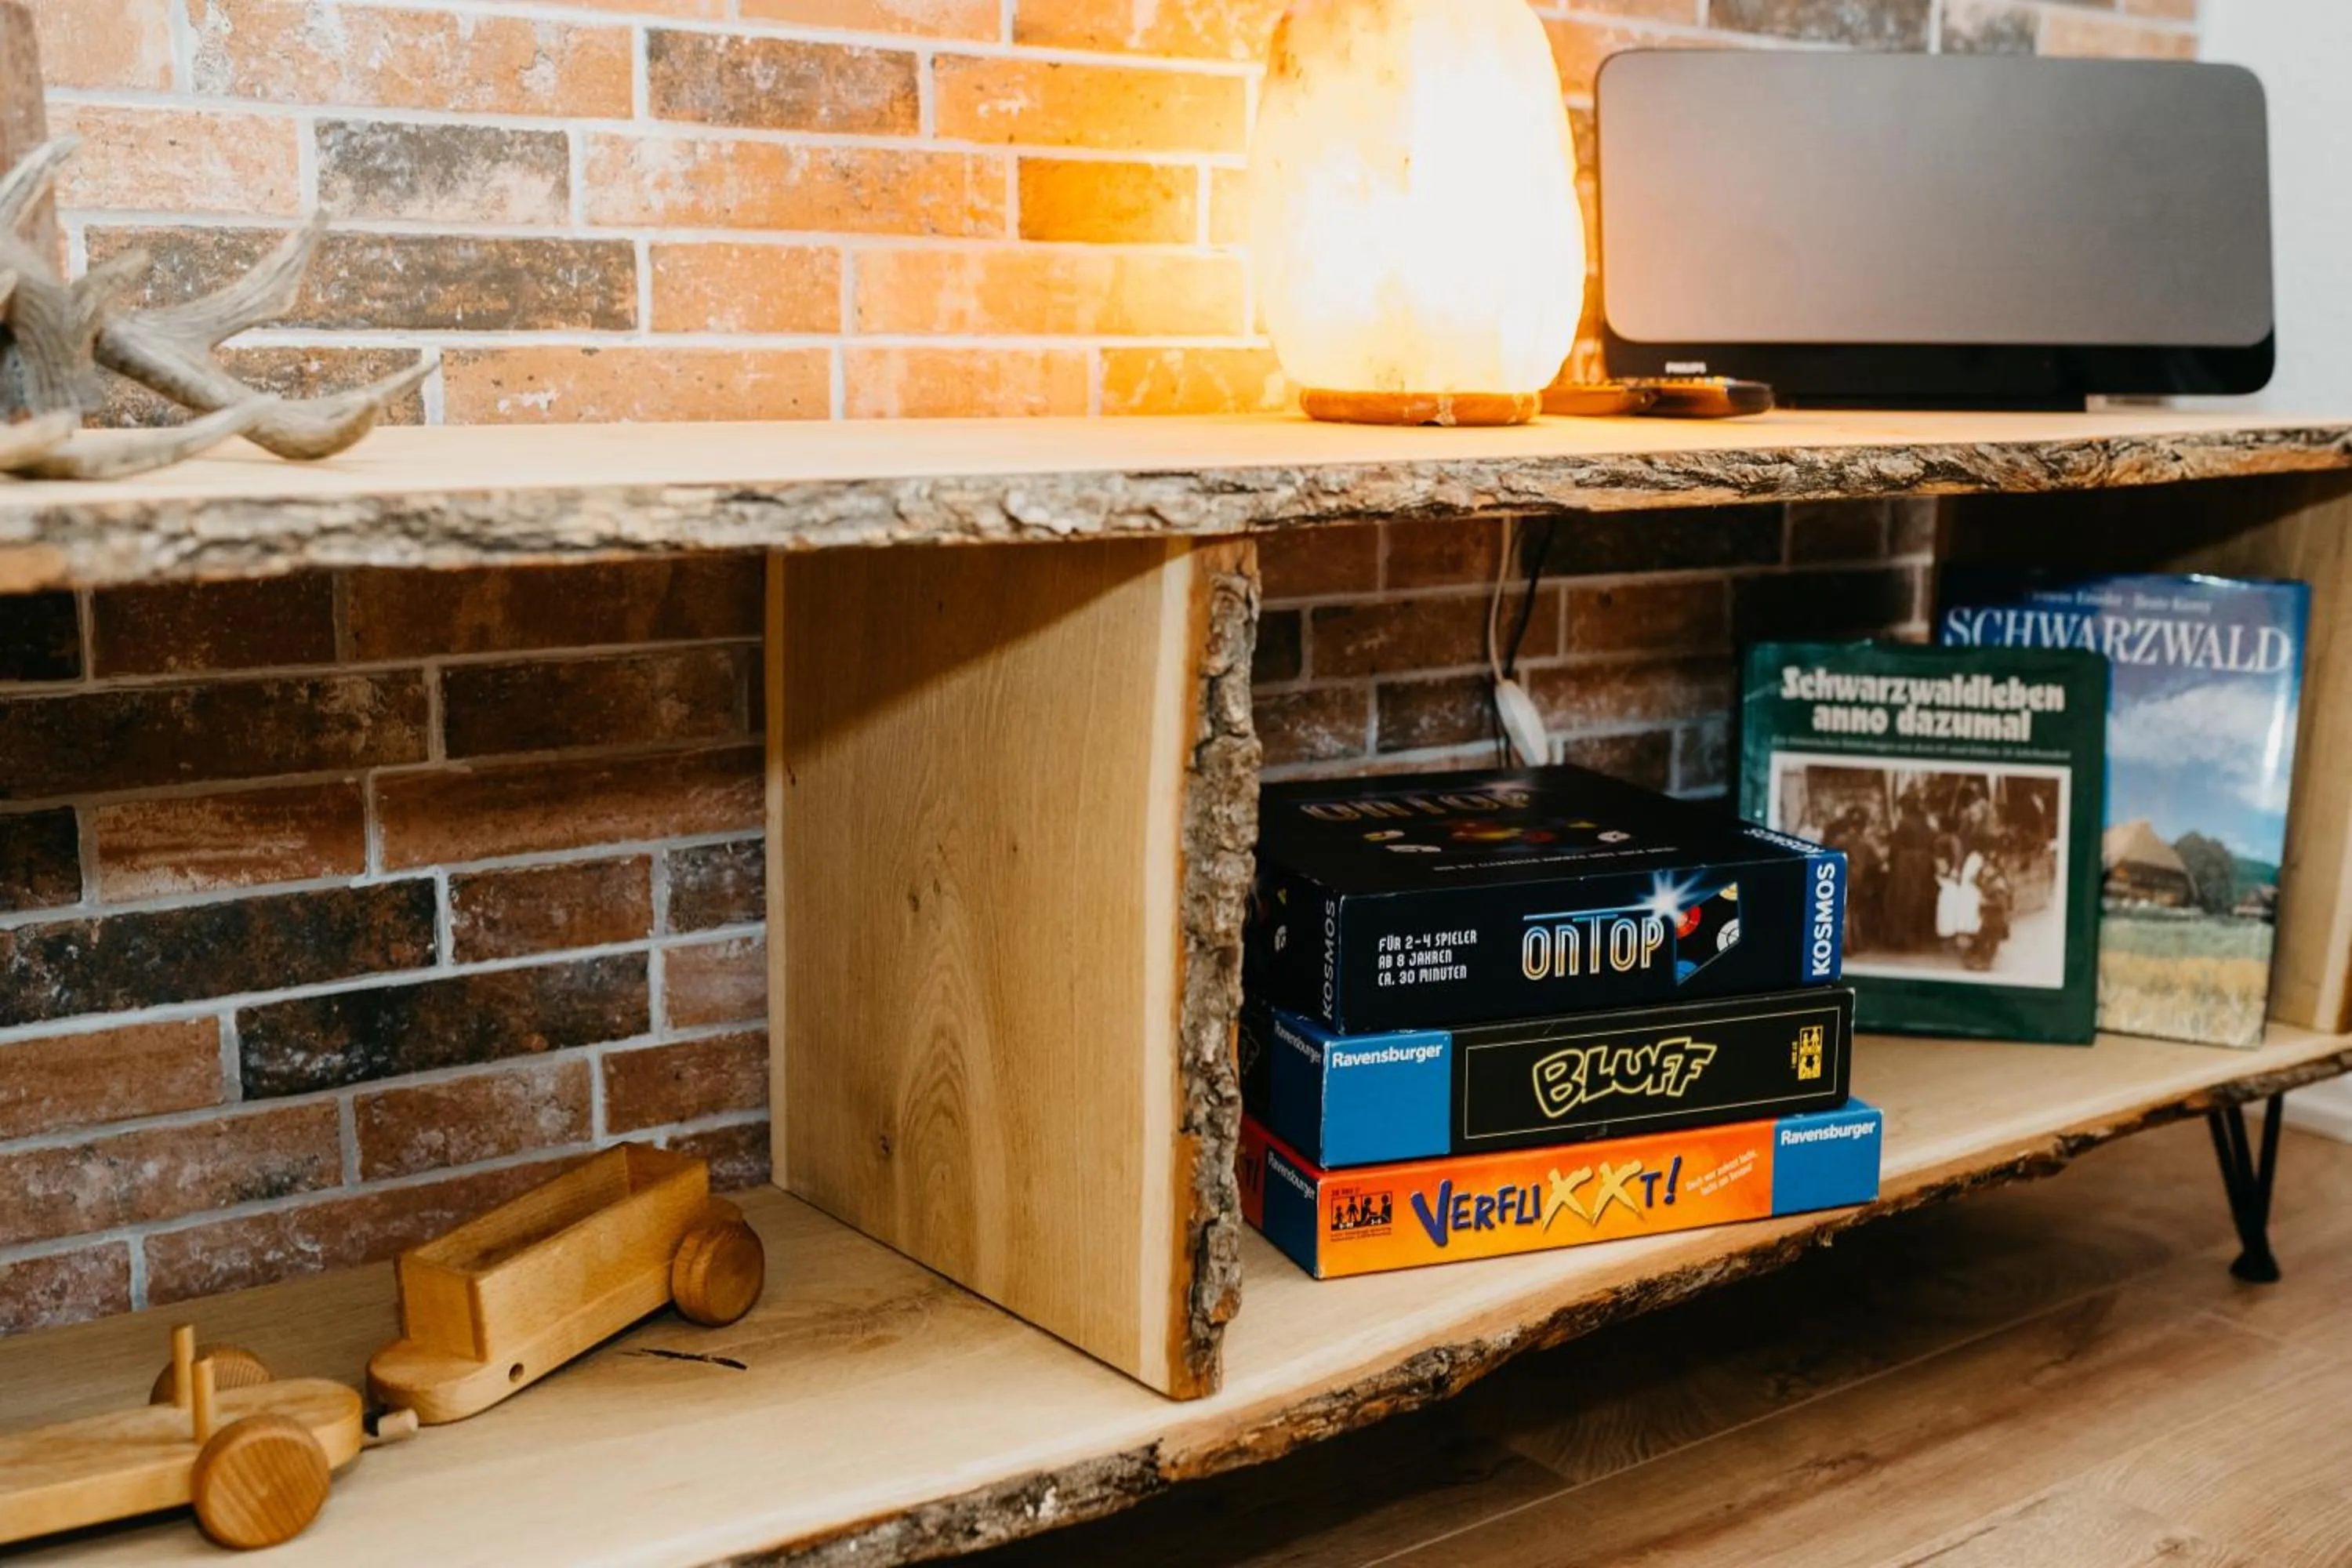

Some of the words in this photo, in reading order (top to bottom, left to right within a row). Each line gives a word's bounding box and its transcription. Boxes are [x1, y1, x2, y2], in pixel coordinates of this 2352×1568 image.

[1944, 606, 2292, 673] SCHWARZWALD
[1780, 666, 2066, 712] Schwarzwaldleben
[1812, 705, 1889, 735] anno
[1896, 704, 2032, 742] dazumal
[1811, 862, 1836, 976] KOSMOS
[1322, 899, 1336, 1020] KOSMOS
[1378, 934, 1402, 953] FÜR
[1404, 933, 1432, 949] 2-4
[1435, 929, 1477, 947] SPIELER
[1378, 954, 1394, 969] AB
[1396, 953, 1405, 967] 8
[1409, 949, 1453, 967] JAHREN
[1377, 971, 1395, 986] CA.
[1399, 970, 1415, 985] 30
[1419, 964, 1467, 982] MINUTEN
[1331, 1043, 1444, 1069] Ravensburger
[1532, 1036, 1718, 1118] BLUFF
[1780, 1120, 1877, 1146] Ravensburger
[1410, 1154, 1682, 1248] VERFLIXXT!
